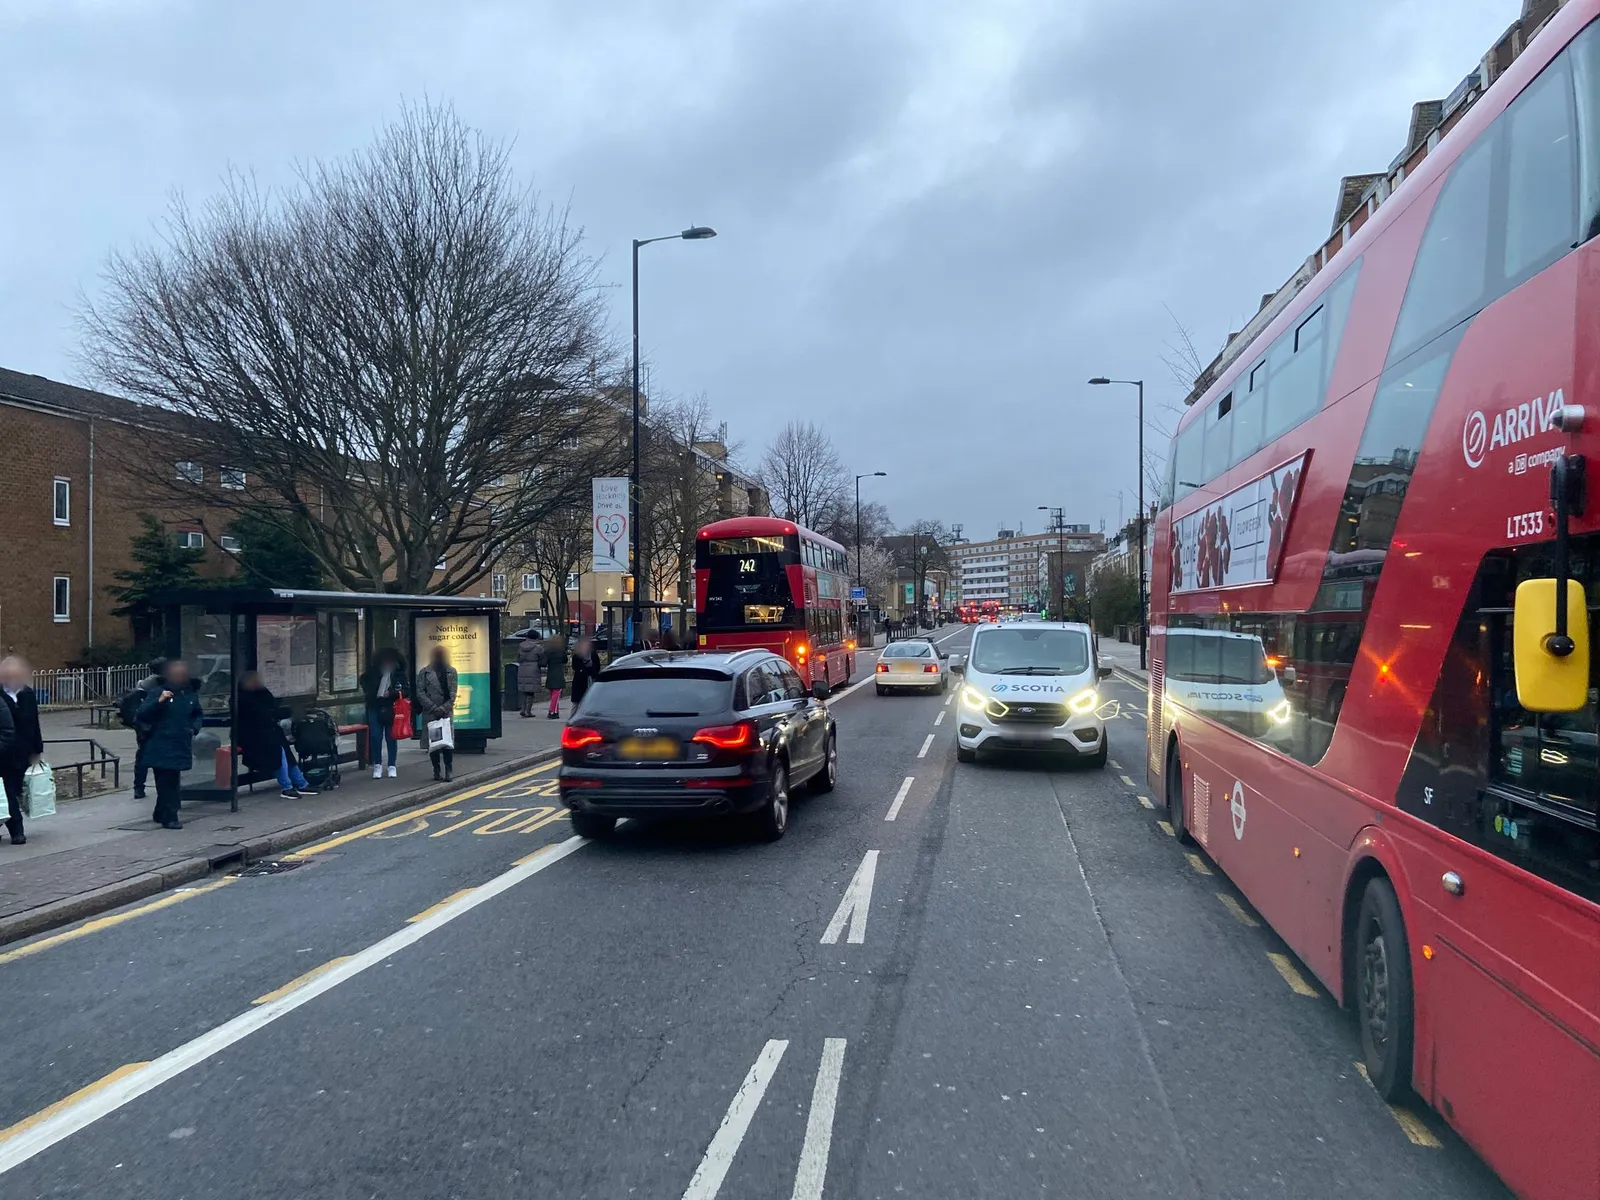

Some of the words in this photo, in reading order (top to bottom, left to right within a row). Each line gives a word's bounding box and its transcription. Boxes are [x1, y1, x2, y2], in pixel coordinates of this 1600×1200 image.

[1490, 388, 1565, 450] ARRIVA
[1508, 462, 1513, 473] a
[1515, 455, 1527, 474] DB
[601, 484, 618, 492] Love
[604, 522, 619, 534] 20
[1507, 511, 1543, 538] LT533
[740, 559, 755, 572] 242
[436, 625, 468, 633] Nothing
[1011, 684, 1065, 692] SCOTIA
[1424, 786, 1433, 805] SF
